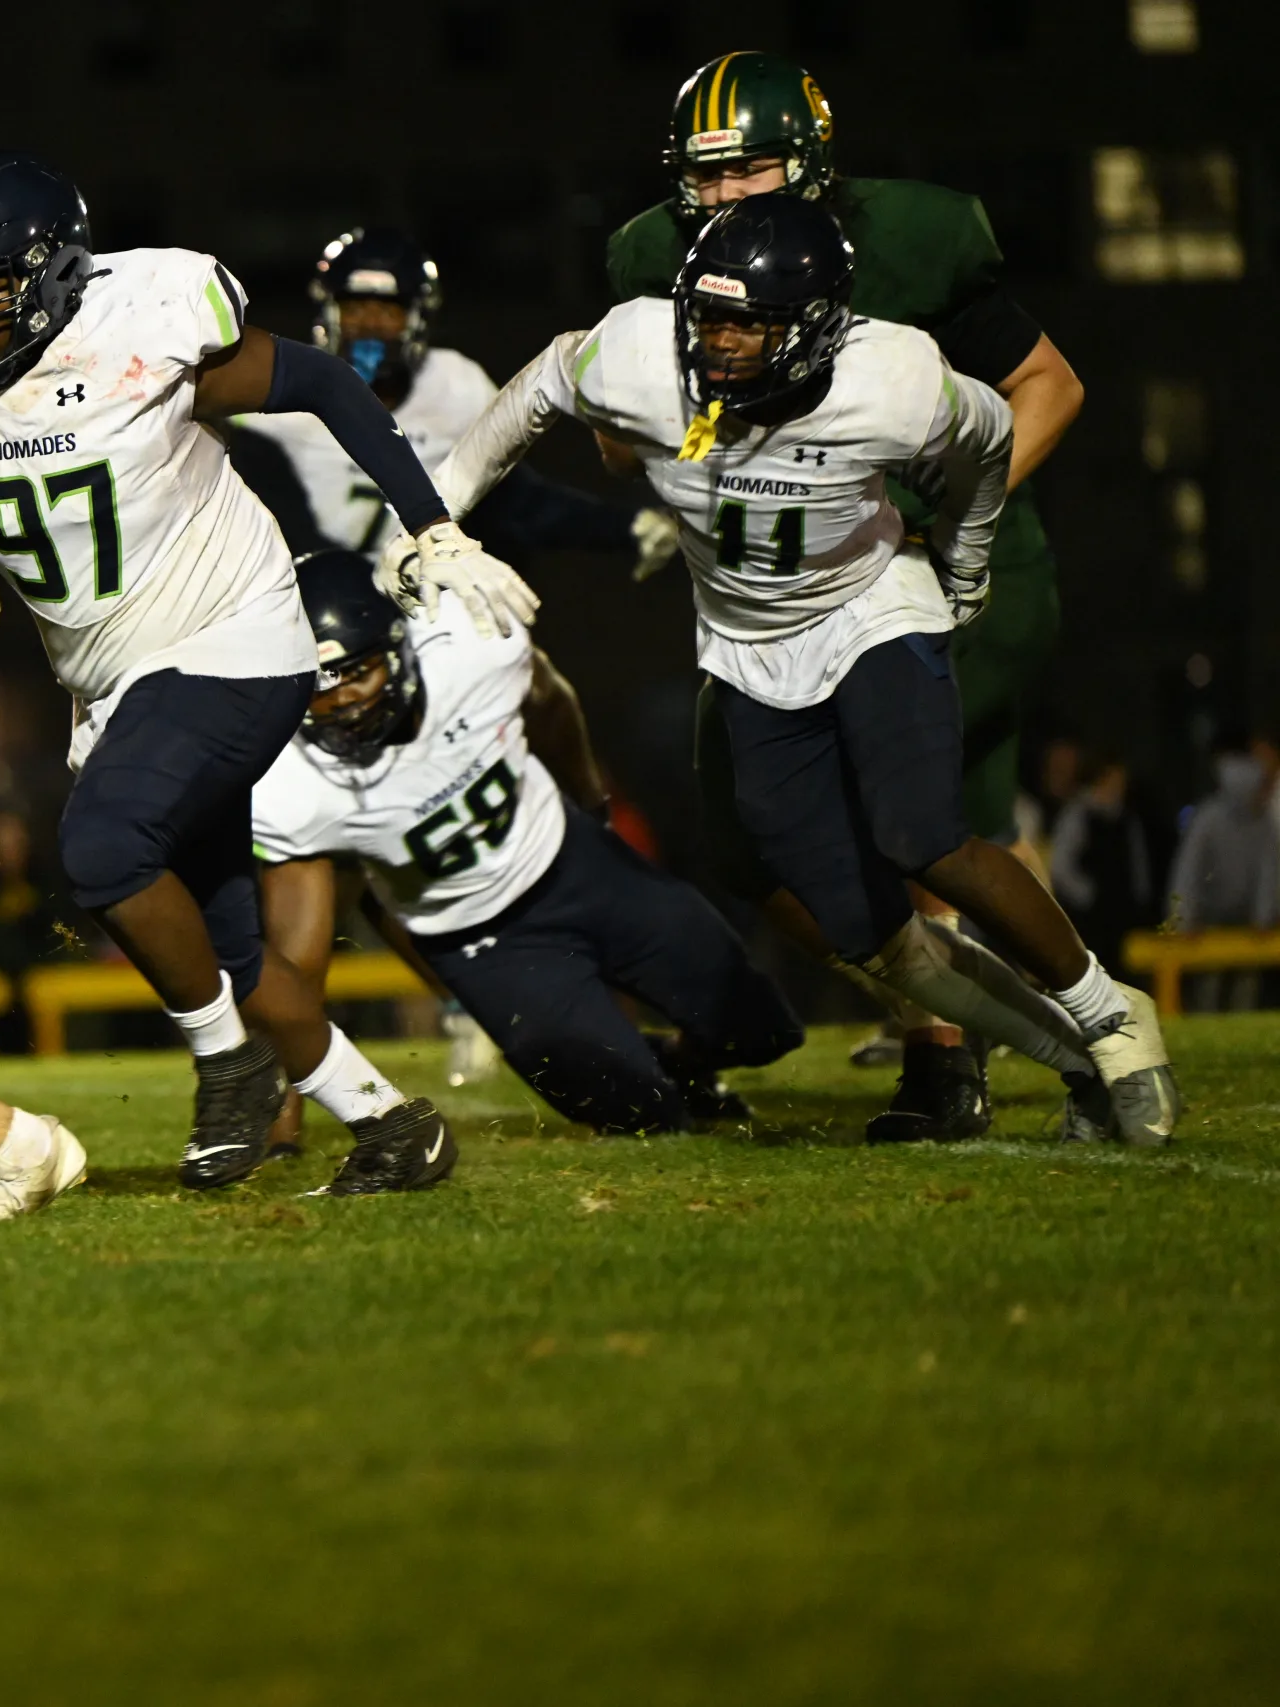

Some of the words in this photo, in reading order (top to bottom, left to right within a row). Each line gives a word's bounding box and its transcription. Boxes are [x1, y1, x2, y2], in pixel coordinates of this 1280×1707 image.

[701, 278, 738, 293] Riddell
[716, 475, 811, 496] NOMADES
[710, 499, 805, 576] 11
